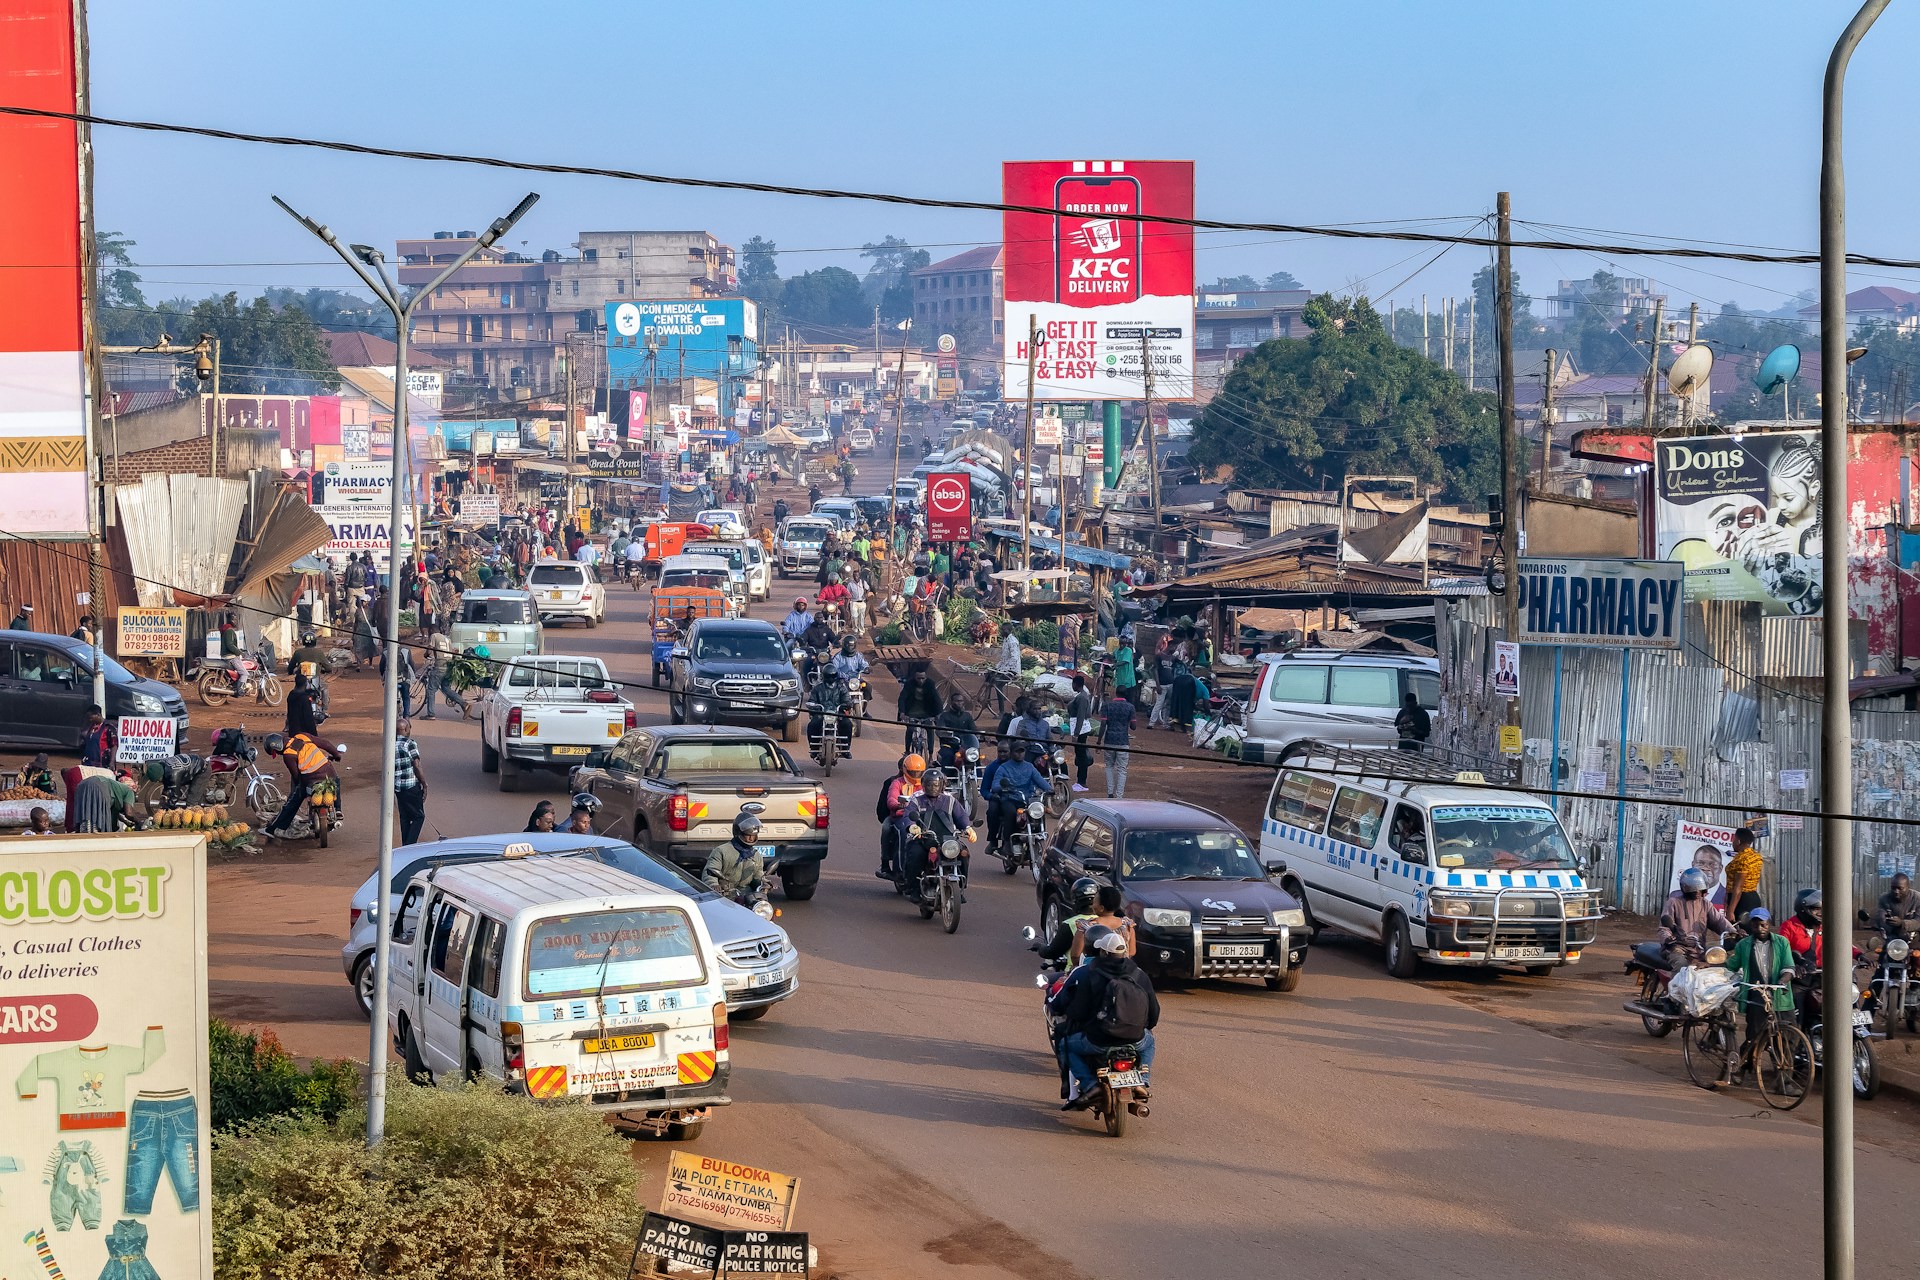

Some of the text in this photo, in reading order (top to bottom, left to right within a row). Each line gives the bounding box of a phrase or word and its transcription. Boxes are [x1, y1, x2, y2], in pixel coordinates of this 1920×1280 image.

[1066, 204, 1129, 213] ORDER NOW
[1069, 258, 1130, 278] KFC
[1068, 281, 1129, 293] DELIVERY
[640, 304, 708, 314] ICON MEDICAL
[653, 314, 693, 324] CENTRE
[1047, 321, 1097, 339] GET IT
[1057, 341, 1097, 359] FAST
[1120, 354, 1139, 364] +256
[1154, 354, 1167, 364] 551
[1169, 354, 1182, 364] 156
[1037, 361, 1097, 379] & EASY
[405, 375, 435, 383] OCCER
[590, 459, 641, 468] Bread Point
[1666, 445, 1744, 472] Dons
[324, 477, 393, 487] PHARMACY
[1713, 470, 1758, 489] Salon
[936, 488, 961, 499] absa
[327, 524, 415, 540] ARMAY
[1518, 563, 1567, 575] UMARONS
[1518, 575, 1679, 638] PHARMACY
[122, 615, 182, 627] BULOOKA WA
[124, 634, 180, 642] 0700108042
[1519, 635, 1538, 643] TAIL,
[1540, 636, 1580, 644] EFFECTIVE
[124, 642, 180, 651] 0782973612
[122, 719, 172, 738] BULOOKA
[119, 752, 138, 760] 0700
[141, 753, 153, 761] 108
[1462, 772, 1480, 780] TAXI
[1434, 807, 1548, 820] EXECUTIVE
[698, 826, 805, 835] RAGER
[1681, 834, 1717, 845] EMMANUEL
[510, 845, 530, 854] TAXI
[0, 866, 166, 920] CLOSET
[13, 935, 142, 955] Casual Clothes
[1220, 946, 1259, 956] UBH 283U
[1504, 948, 1540, 958] UBD 850S
[18, 962, 99, 980] deliveries
[0, 1003, 58, 1034] ARS
[599, 1036, 648, 1050] UBA 800V
[701, 1158, 771, 1183] BULOOKA
[672, 1166, 778, 1202] WA PLOT, ETTAKA,
[697, 1187, 771, 1213] NAMAYUMBA
[668, 1192, 782, 1226] 0752516968/0774165554
[667, 1221, 691, 1236] NO
[644, 1229, 718, 1258] PARKING
[745, 1232, 768, 1243] NO
[640, 1242, 714, 1269] POLICE NOTICE
[726, 1244, 803, 1260] PARKING
[725, 1260, 804, 1273] POLICE NOTICE
